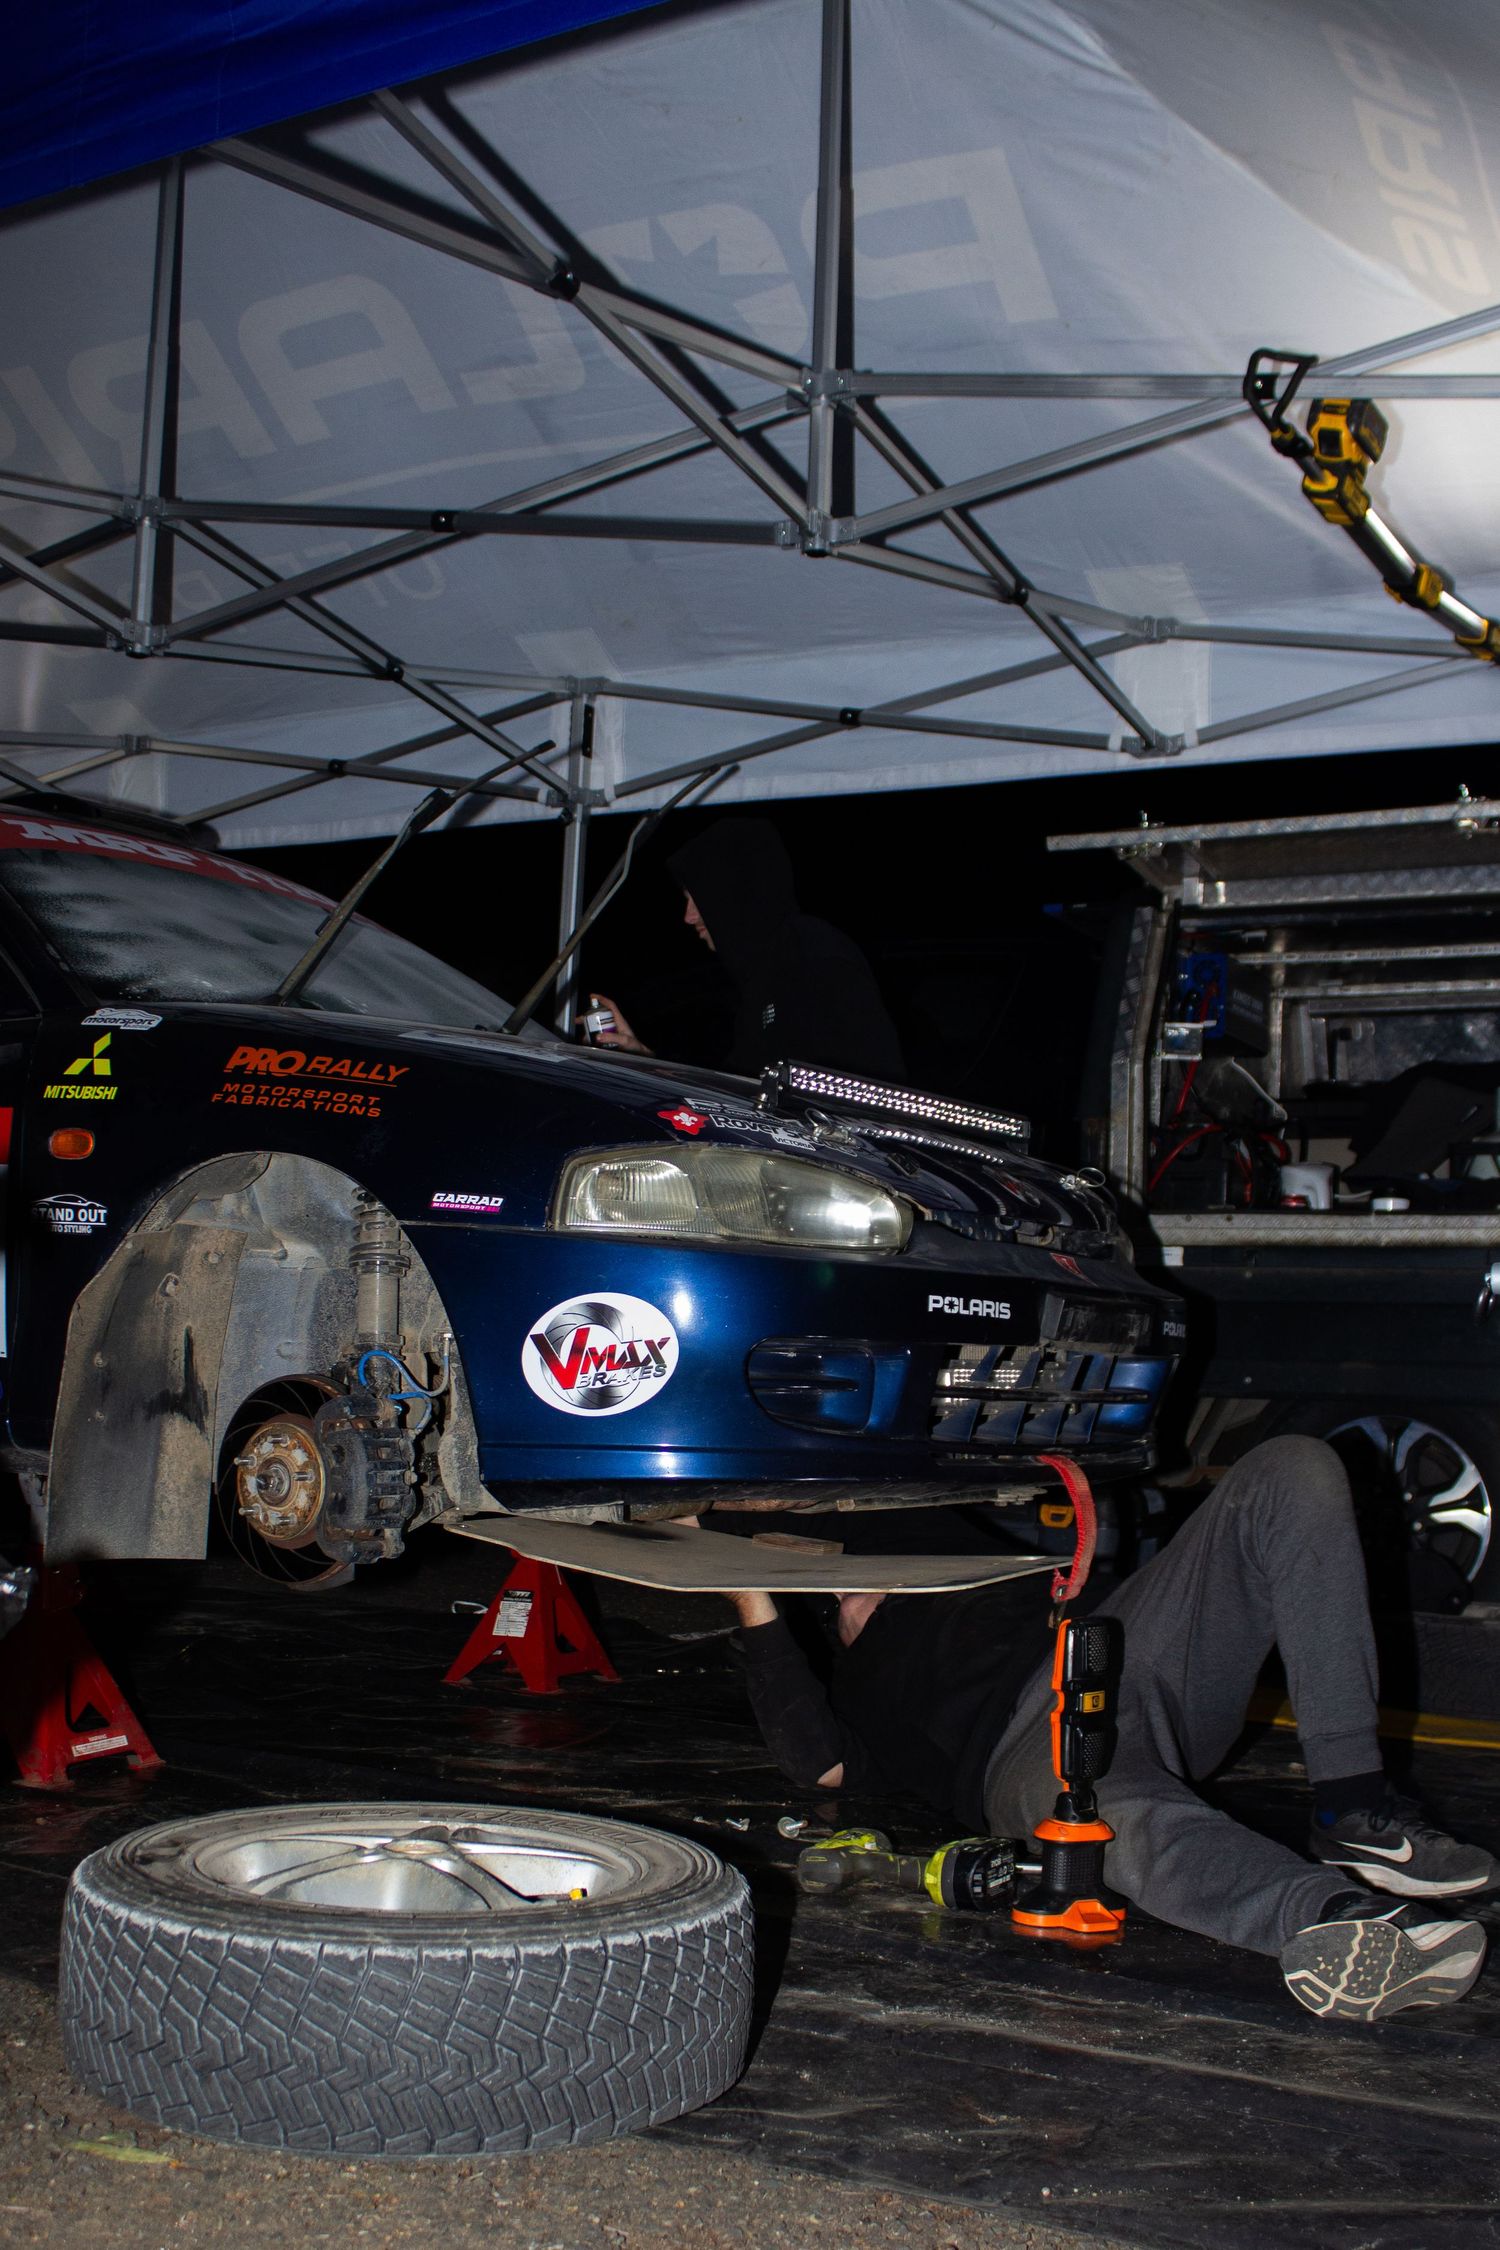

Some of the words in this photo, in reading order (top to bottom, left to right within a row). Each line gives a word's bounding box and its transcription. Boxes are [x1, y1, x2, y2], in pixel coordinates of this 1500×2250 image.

[1, 819, 200, 867] MRF
[224, 1046, 307, 1077] PRO
[306, 1056, 411, 1082] RALLY
[43, 1085, 118, 1100] MITSUBISHI
[222, 1083, 381, 1106] MOTORSPORT
[211, 1093, 382, 1117] FABRICATIONS
[775, 1136, 813, 1149] VICTORIA
[432, 1193, 504, 1207] GARRAD
[432, 1202, 486, 1211] MOTORSPORT
[78, 1208, 108, 1222] OUT
[64, 1224, 92, 1234] STYLING
[927, 1294, 1011, 1319] POLARIS
[530, 1327, 671, 1390] VMAX
[576, 1363, 668, 1389] BRAKES
